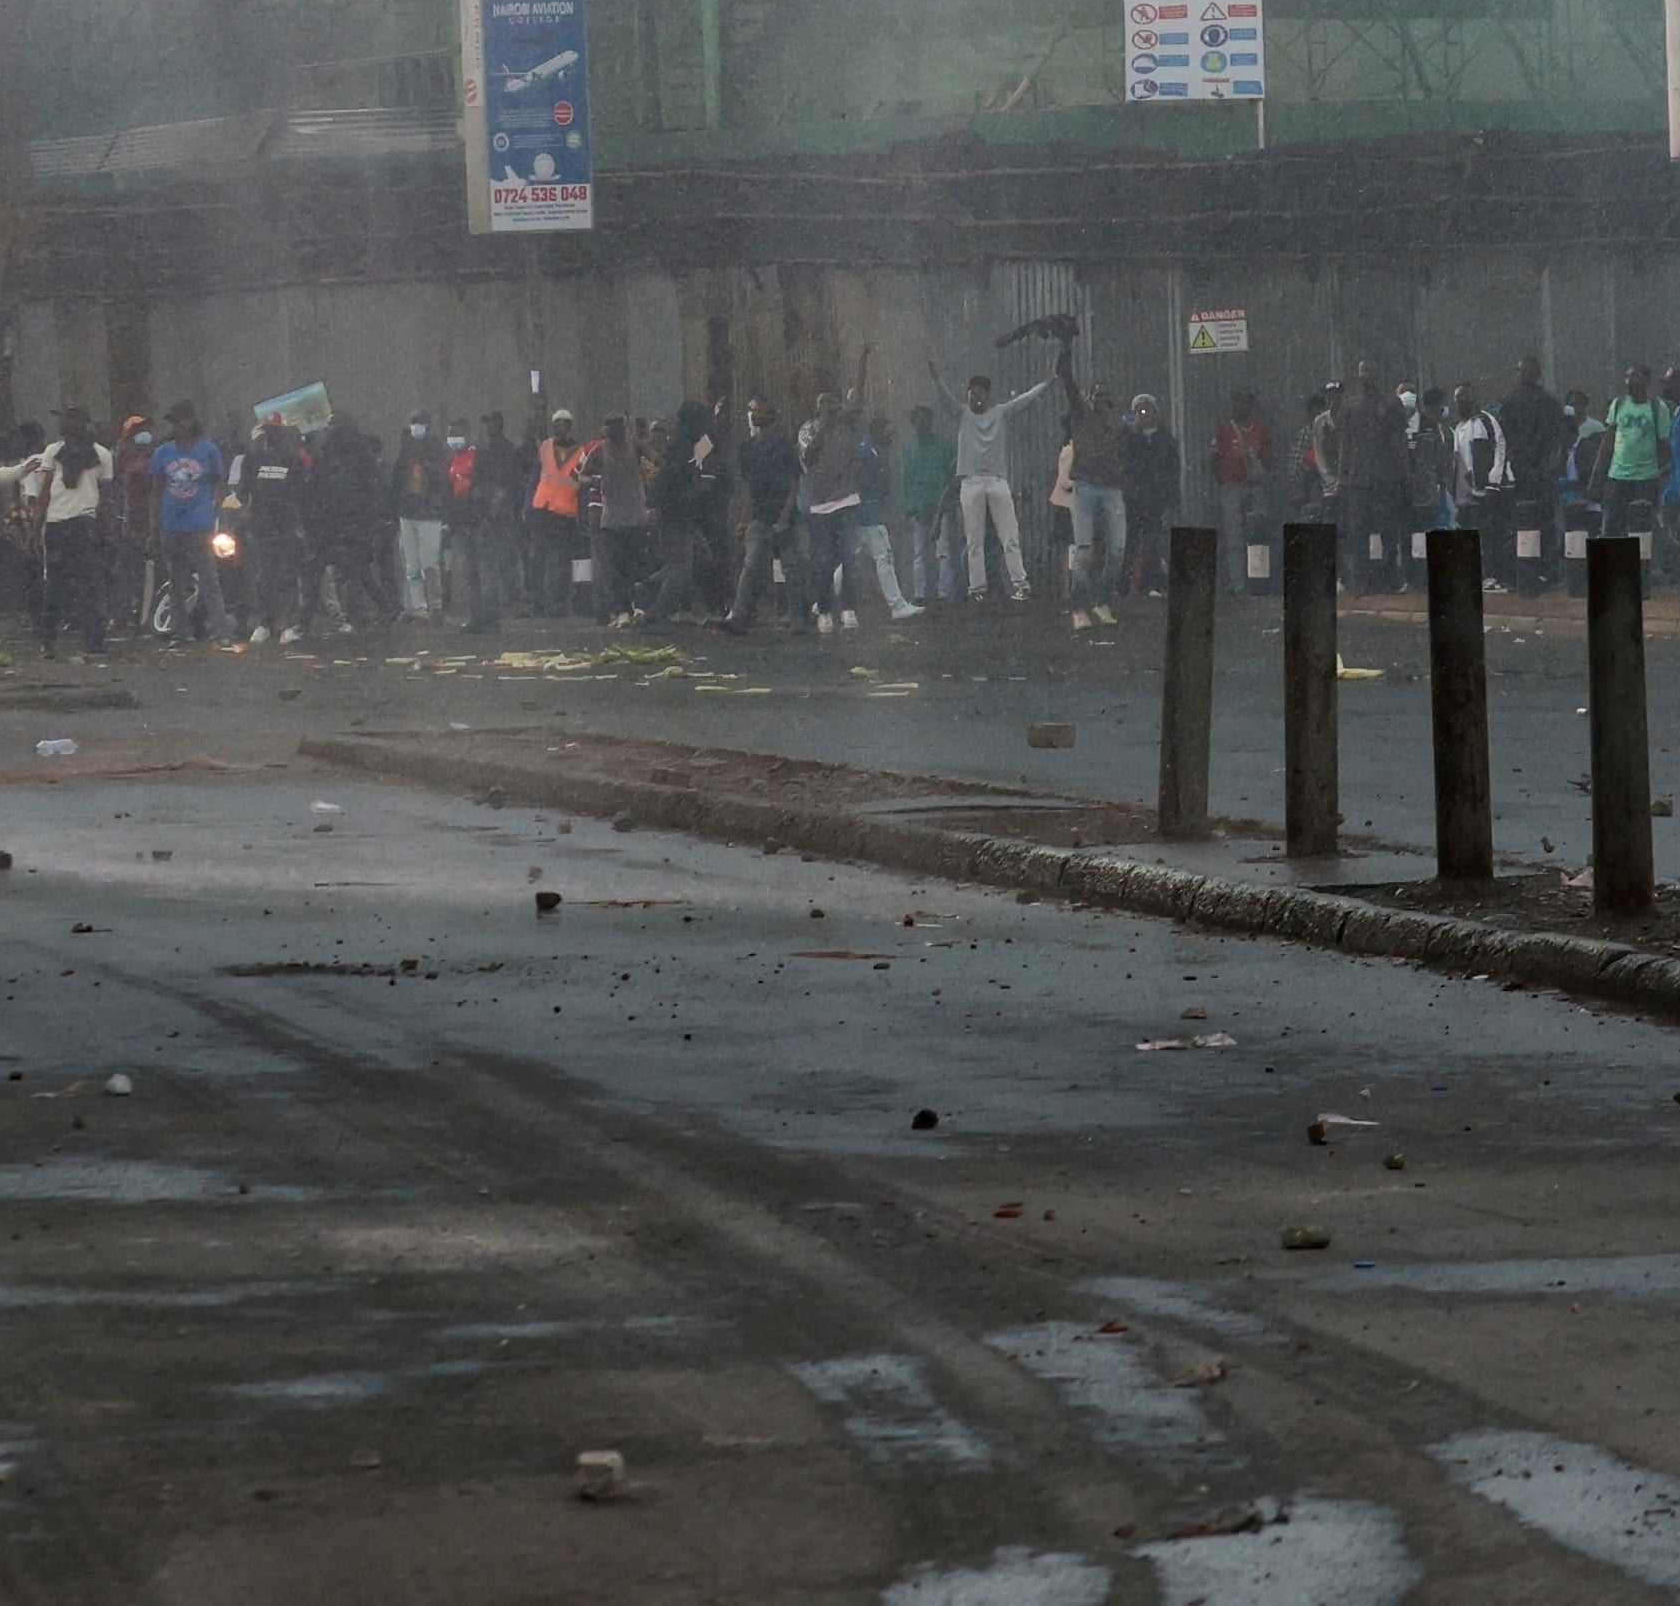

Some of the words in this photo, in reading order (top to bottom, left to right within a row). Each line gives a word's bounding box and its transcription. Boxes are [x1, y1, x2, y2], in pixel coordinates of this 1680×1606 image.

[492, 2, 529, 18] NAIROBI
[532, 0, 574, 16] AVIATION
[494, 188, 528, 204] 0724
[531, 186, 558, 202] 536
[561, 185, 587, 201] 048
[1201, 309, 1246, 321] DANGER
